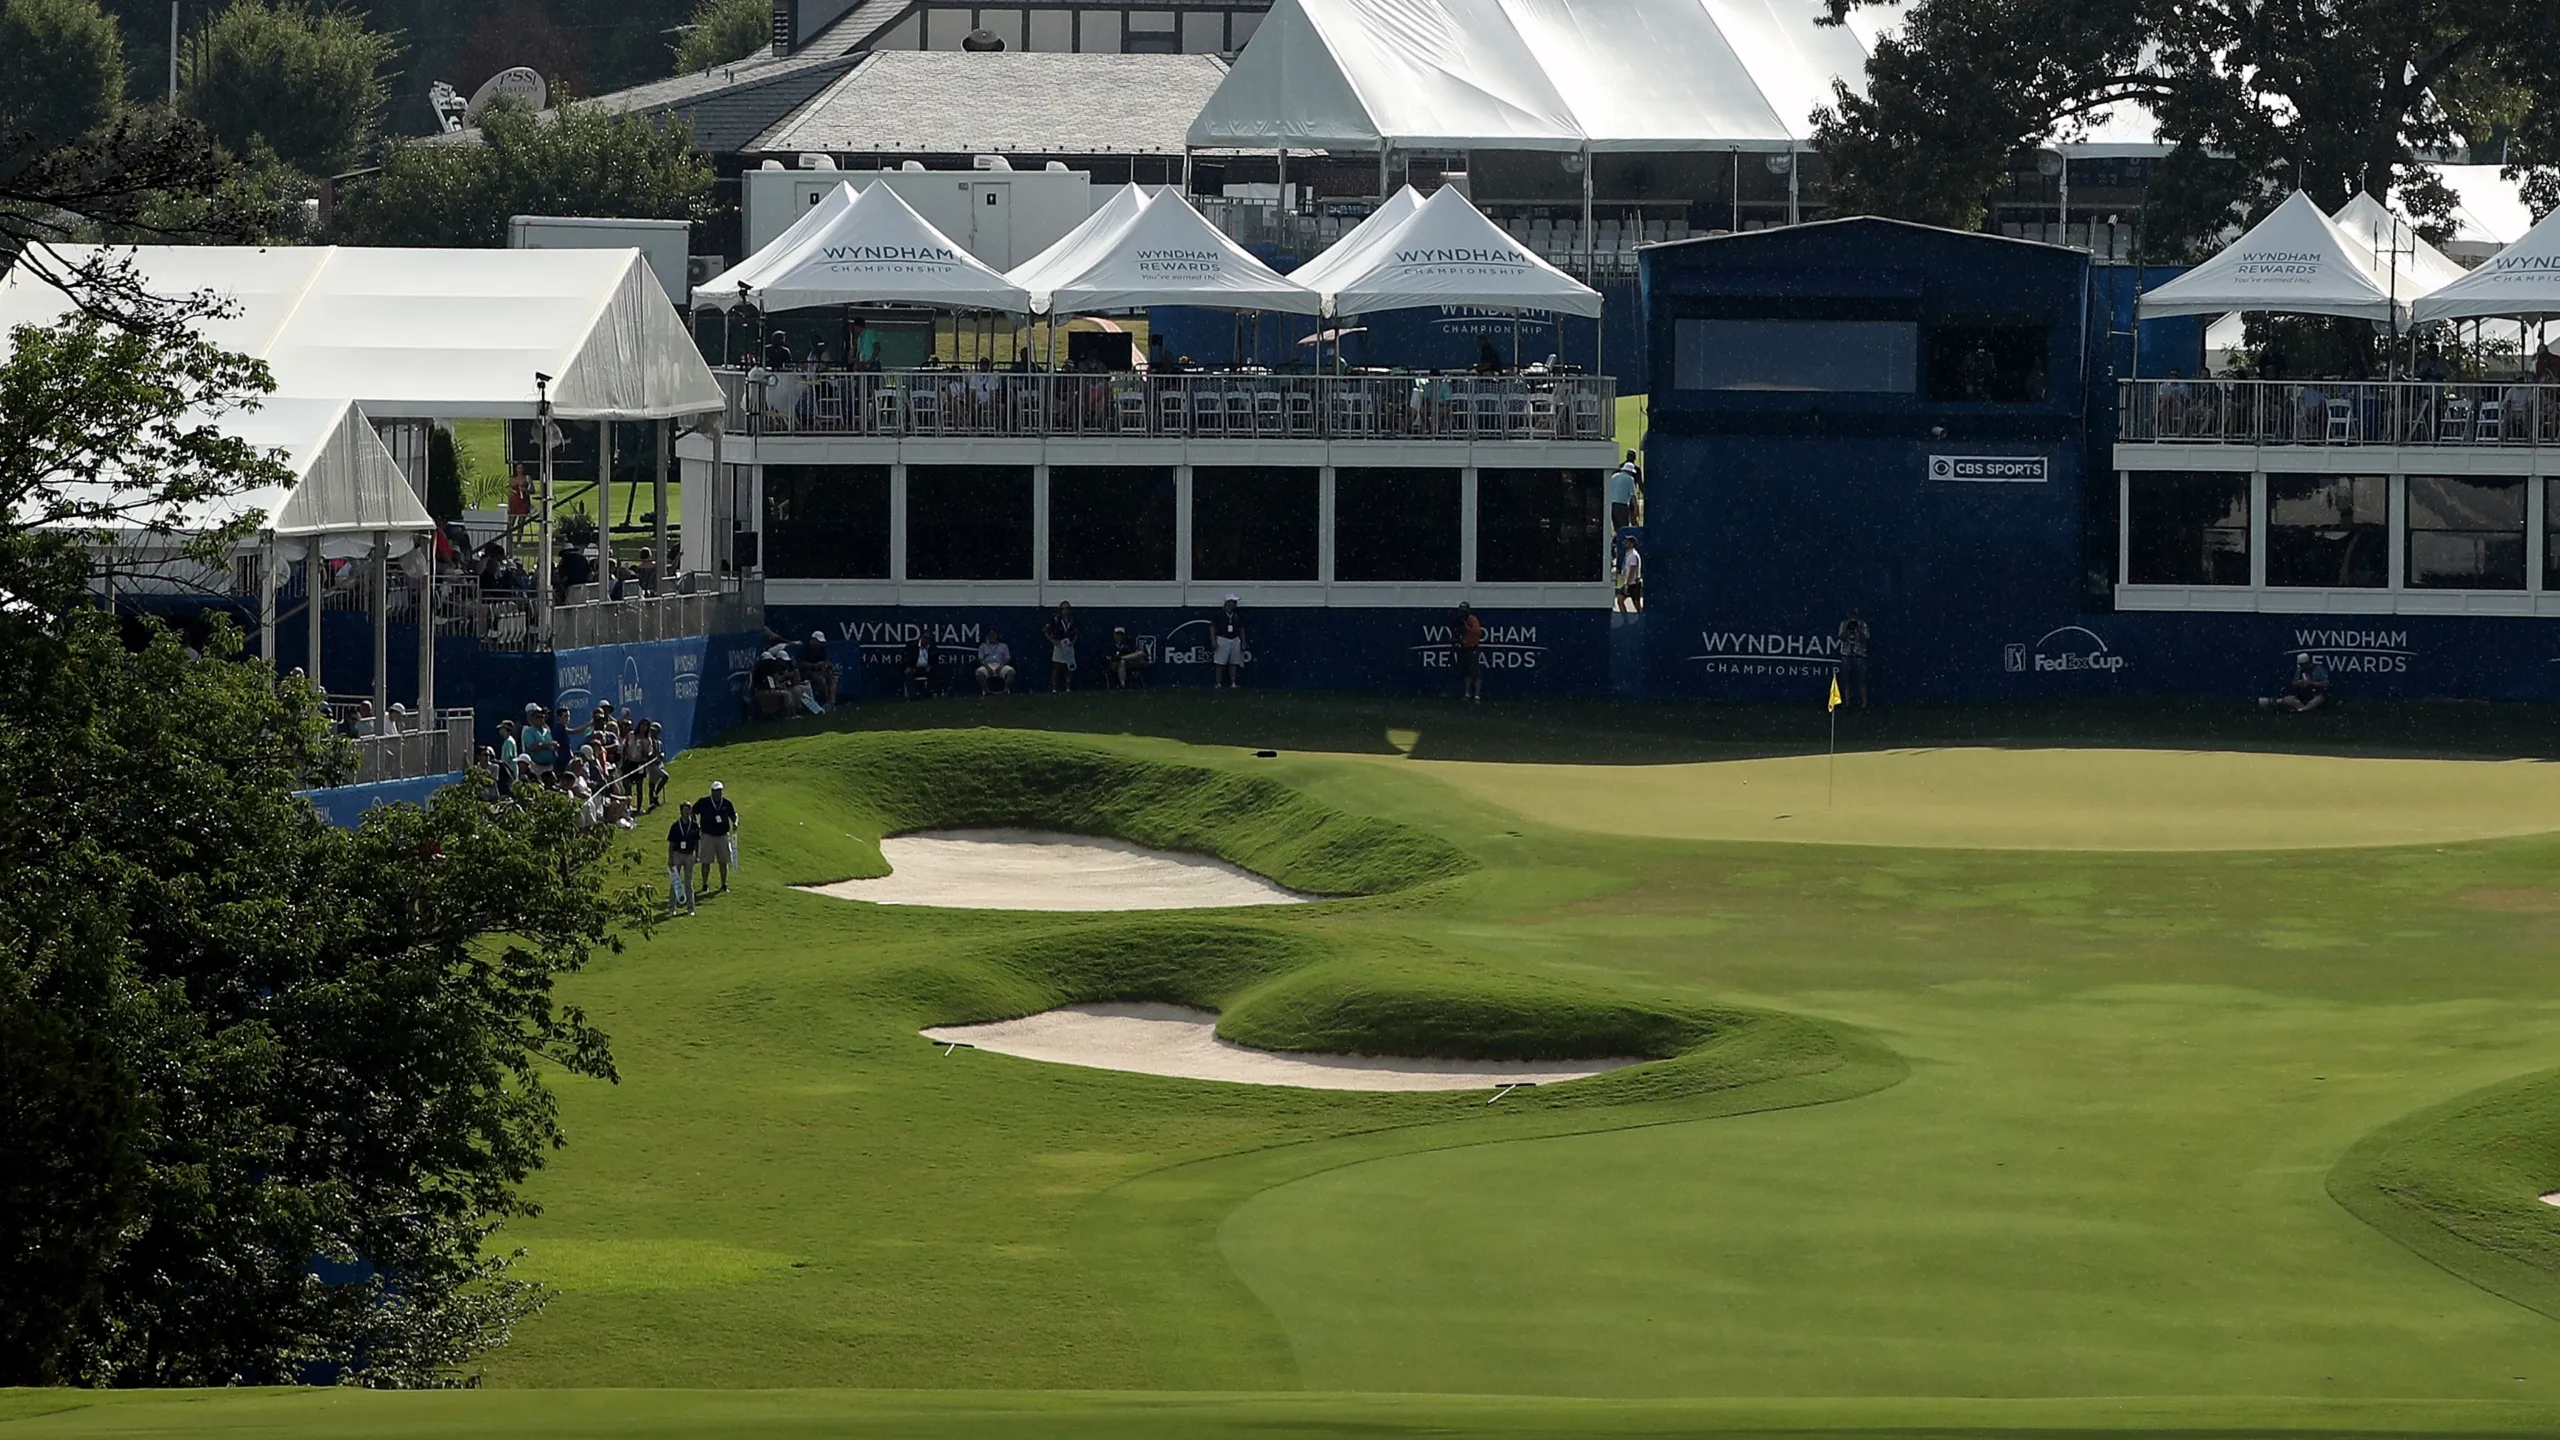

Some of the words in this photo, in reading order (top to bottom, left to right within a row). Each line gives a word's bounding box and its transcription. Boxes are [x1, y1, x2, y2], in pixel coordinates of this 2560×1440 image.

[822, 246, 954, 260] WYNDHAM
[1136, 249, 1219, 260] WYNDHAM
[1395, 249, 1526, 263] WYNDHAM
[2242, 252, 2321, 262] WYNDHAM
[831, 265, 952, 273] CHAMPIONSHIP
[1140, 262, 1220, 272] REWARDS
[1404, 268, 1525, 276] CHAMPIONSHIP
[2238, 265, 2317, 274] REWARDS
[1442, 324, 1543, 334] CHAMPIONHIP
[1956, 463, 1984, 475] CBS
[1986, 463, 2042, 475] SPORTS
[1702, 631, 1844, 655] WYNDHAM
[2295, 629, 2407, 648] WYNDHAM
[2035, 651, 2124, 673] FedExCup
[2312, 655, 2407, 673] EWARDS
[1706, 662, 1841, 676] CHAMPIONSHIP
